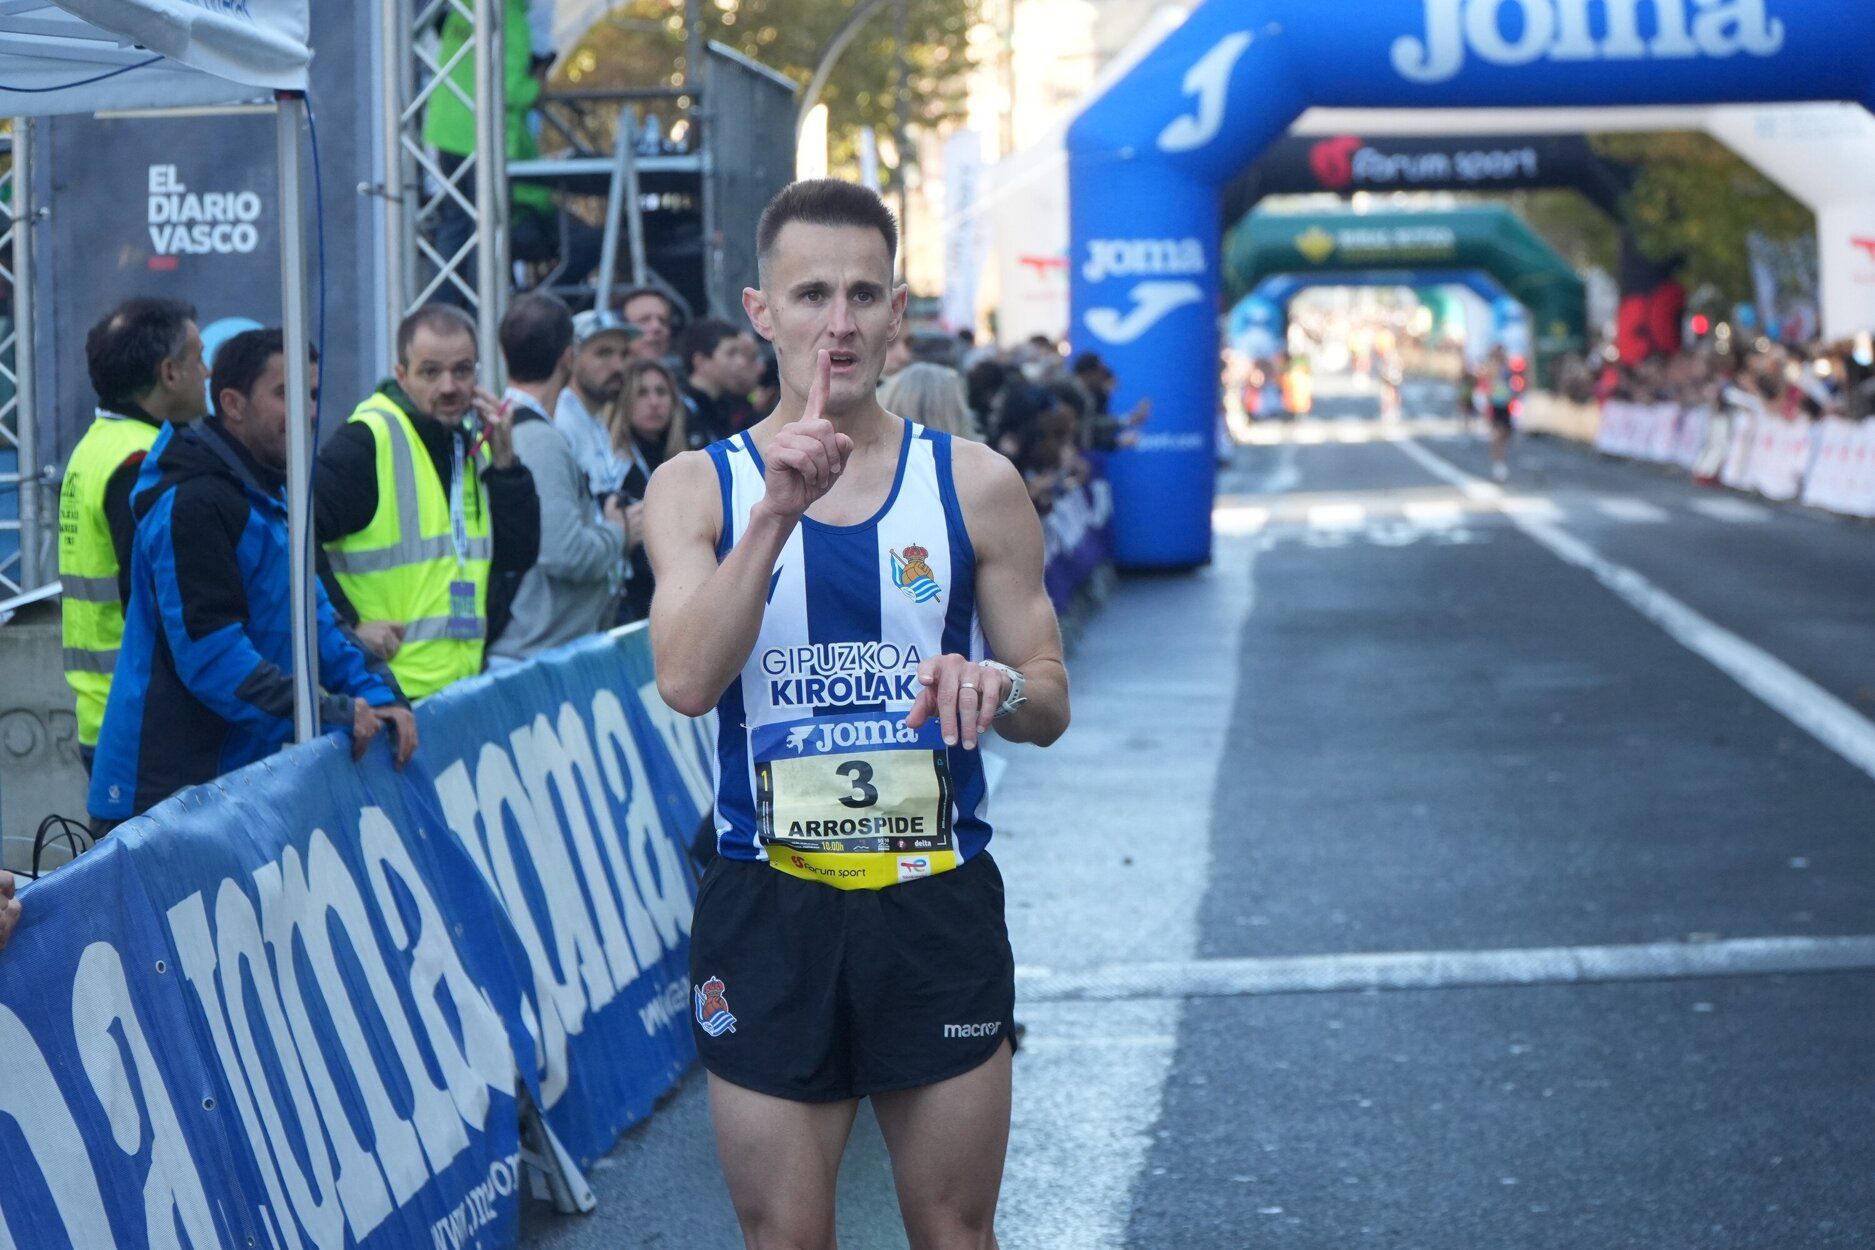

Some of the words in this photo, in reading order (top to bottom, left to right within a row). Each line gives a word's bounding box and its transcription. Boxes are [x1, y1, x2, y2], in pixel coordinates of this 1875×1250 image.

[148, 164, 186, 193] EL
[148, 191, 261, 224] DIARIO
[148, 223, 259, 254] VASCO
[763, 643, 921, 675] GIPUZKOA
[771, 674, 918, 706] KIROLAK
[761, 770, 768, 791] 1
[835, 760, 879, 808] 3
[788, 816, 924, 837] ARROSPIDE
[914, 839, 932, 847] delta
[838, 868, 867, 878] sport
